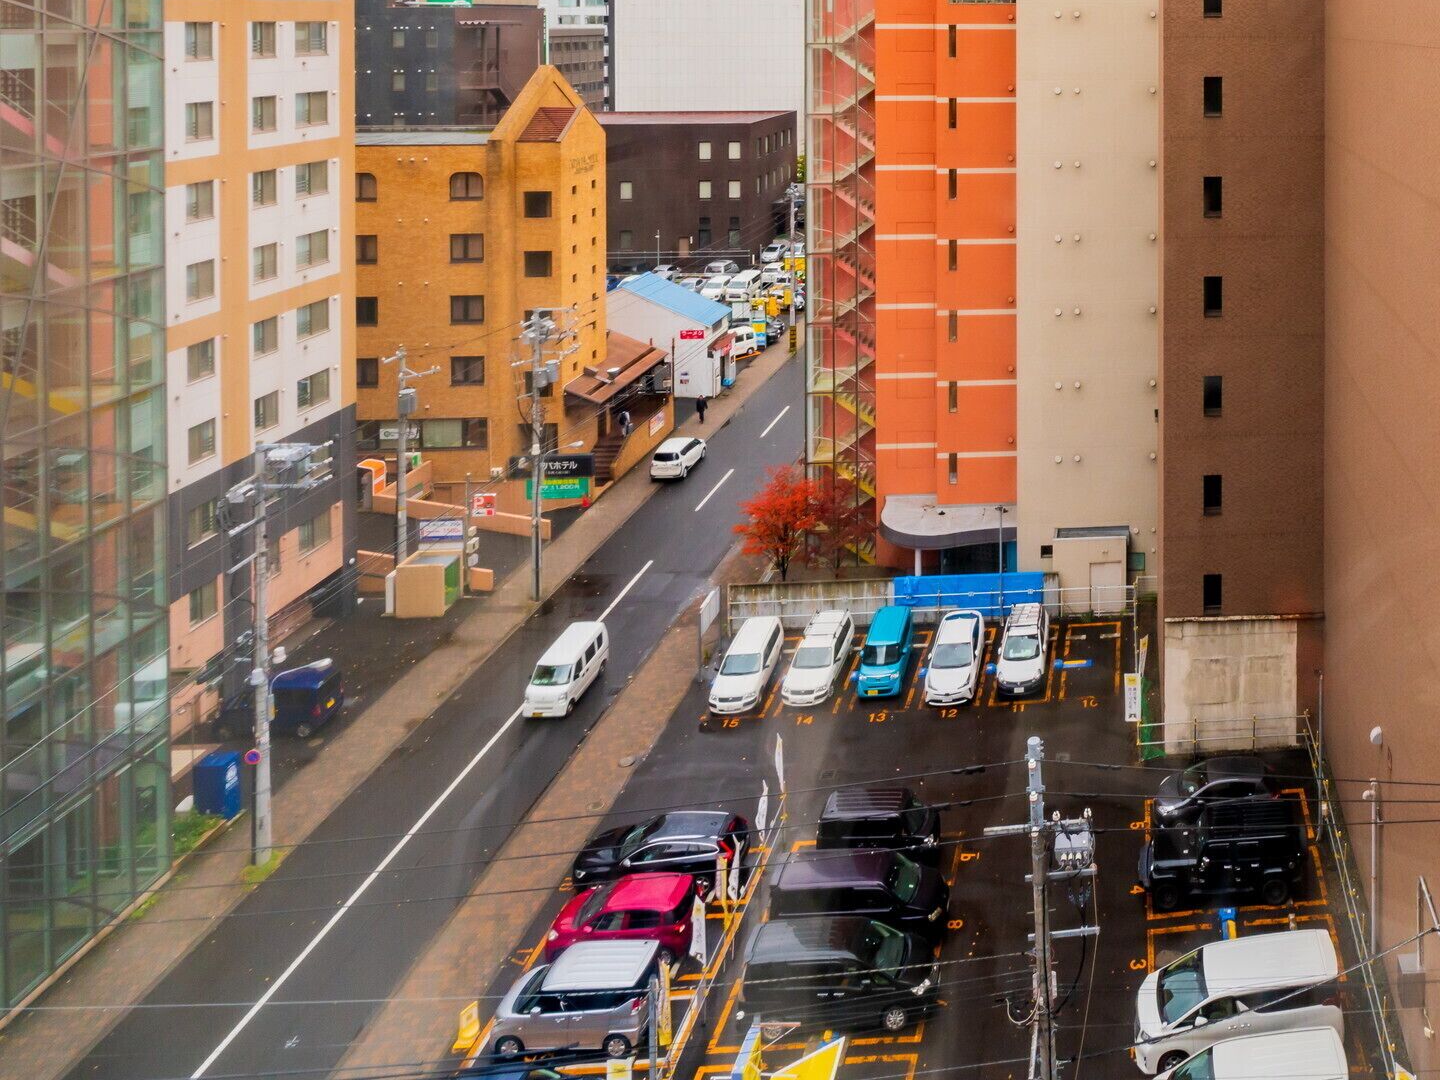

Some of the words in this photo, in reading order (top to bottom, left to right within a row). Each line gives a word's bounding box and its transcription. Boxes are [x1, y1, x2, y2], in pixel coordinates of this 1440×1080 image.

[868, 713, 887, 723] 13
[940, 708, 958, 718] 12
[721, 718, 740, 728] 15
[796, 715, 814, 726] 14
[1129, 885, 1145, 895] 4
[948, 919, 963, 929] 8
[1129, 959, 1147, 970] 3
